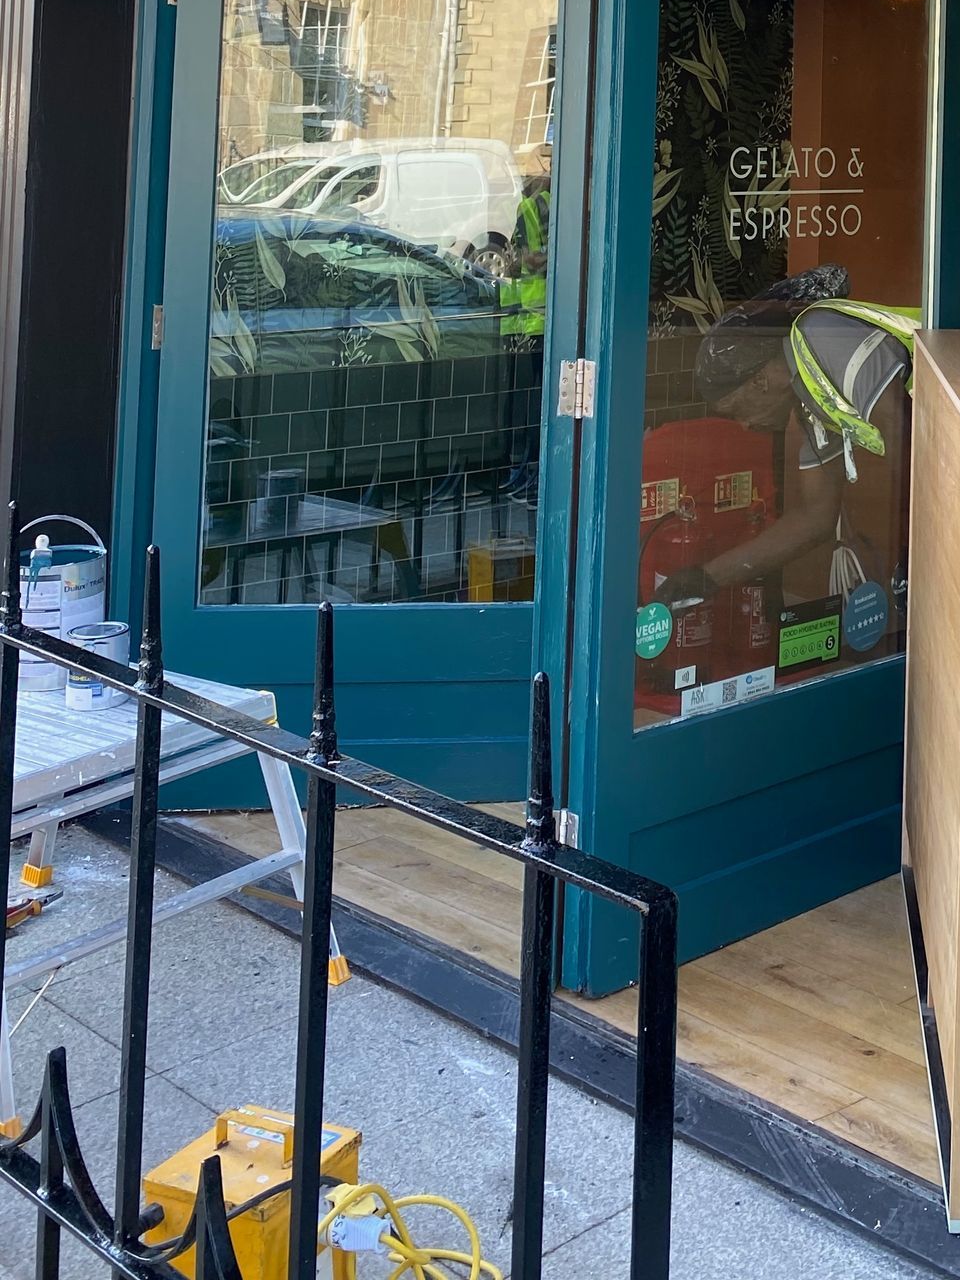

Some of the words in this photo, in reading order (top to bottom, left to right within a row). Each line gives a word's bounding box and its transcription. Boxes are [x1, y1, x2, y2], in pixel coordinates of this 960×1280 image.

[729, 146, 836, 179] GELATO
[847, 147, 864, 178] &
[729, 204, 862, 241] ESPRESSO
[64, 584, 85, 593] Dulux
[636, 618, 669, 638] VEGAN
[783, 629, 798, 638] FOOD
[690, 688, 705, 706] ASK
